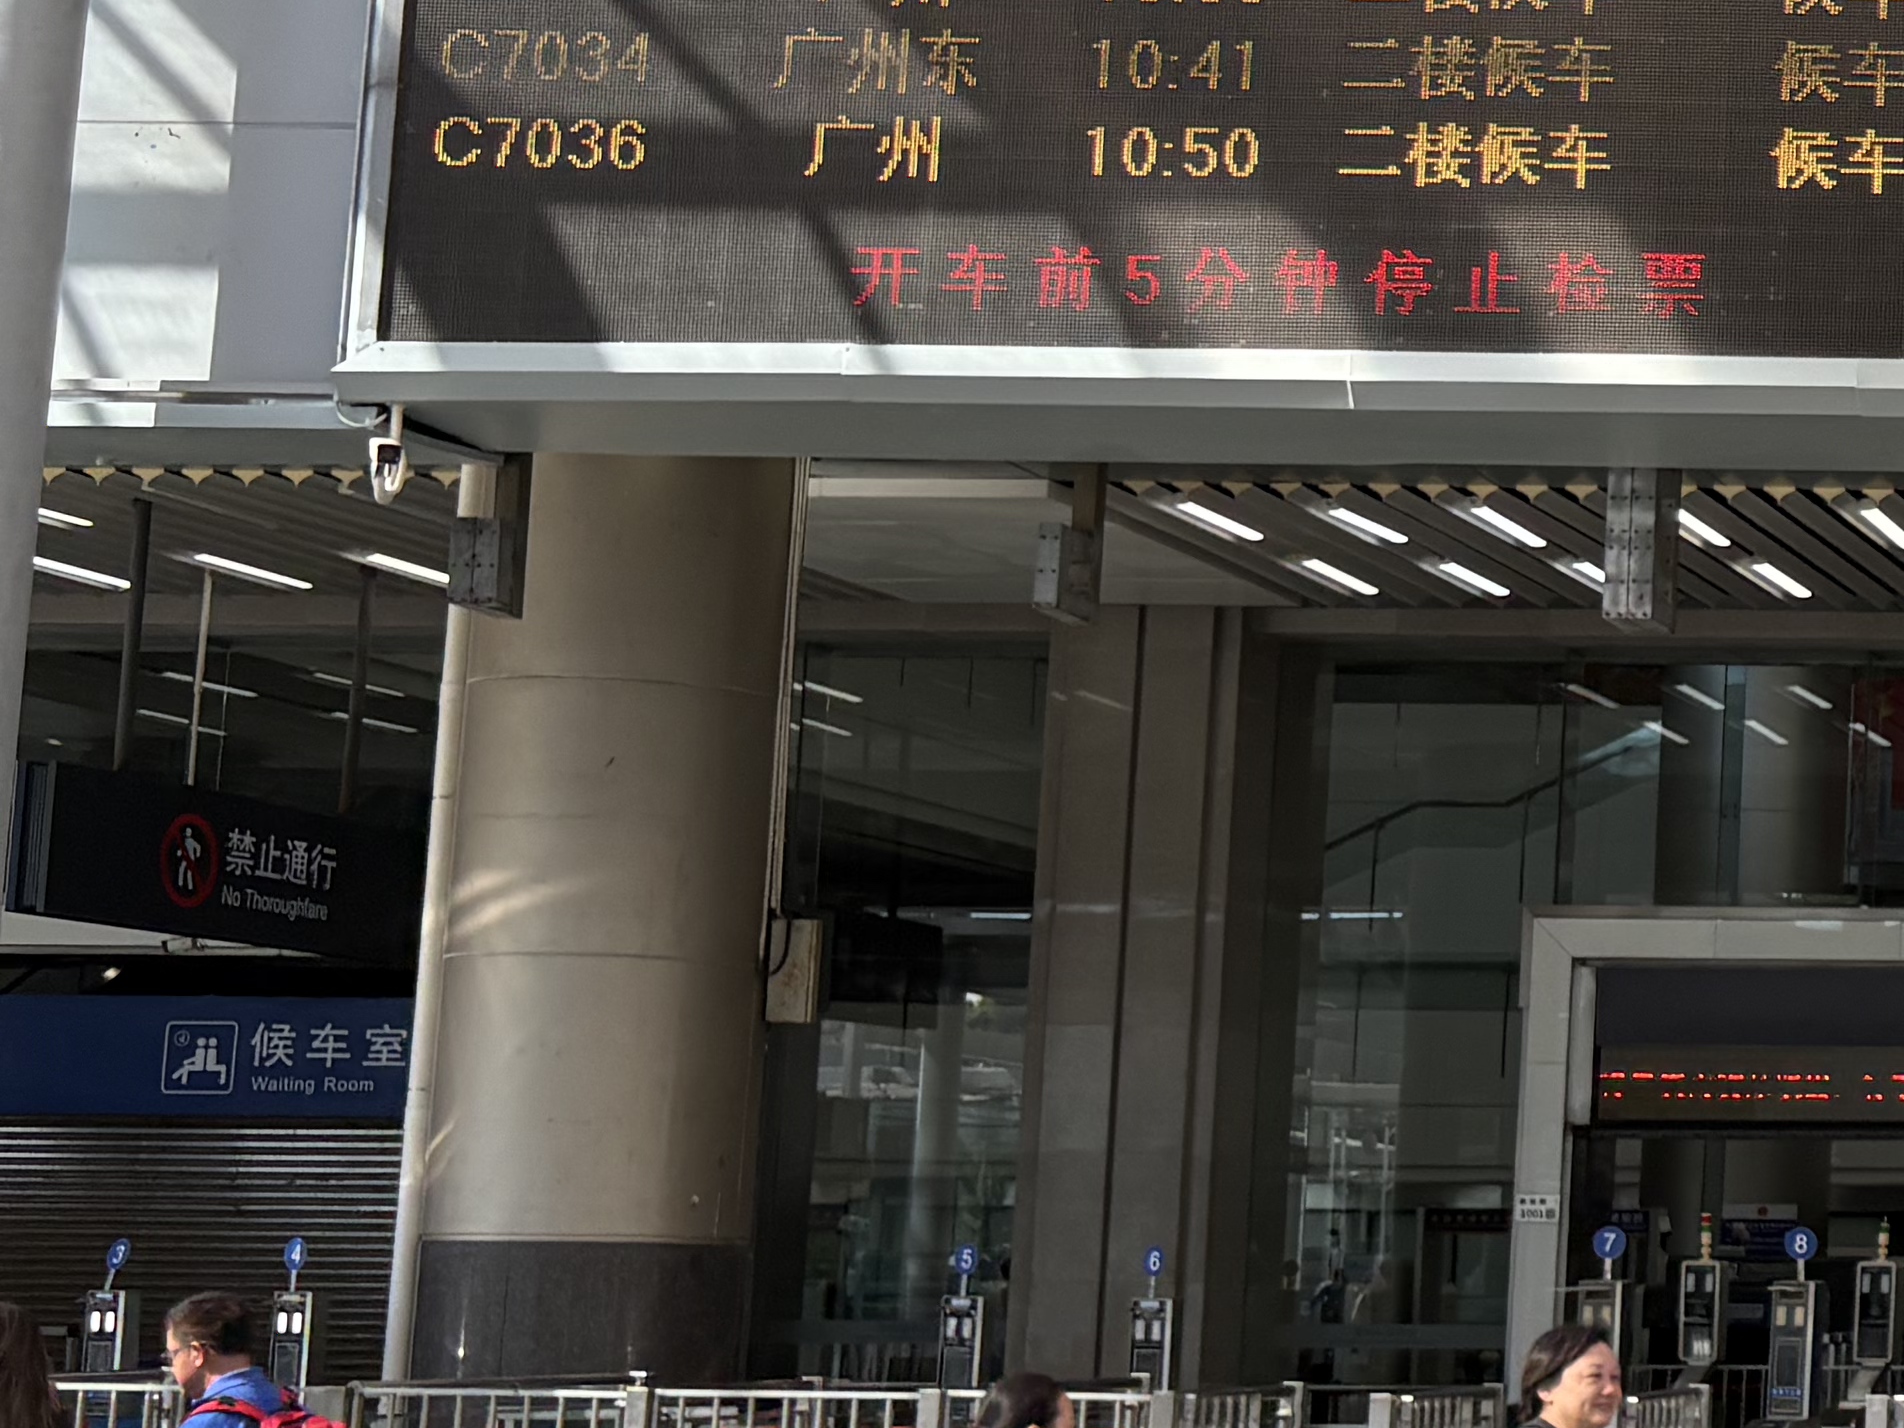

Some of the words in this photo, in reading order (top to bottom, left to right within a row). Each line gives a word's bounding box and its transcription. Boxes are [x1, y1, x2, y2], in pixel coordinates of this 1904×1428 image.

[440, 29, 651, 82] C7034
[772, 27, 980, 95] 广州东
[1091, 38, 1256, 90] 10:41
[1342, 35, 1614, 102] 二楼候车
[434, 118, 645, 170] C7036
[805, 117, 941, 182] 广州
[1089, 128, 1258, 178] 10:50
[1340, 124, 1609, 189] 二楼候车
[1771, 129, 1904, 195] 候车
[850, 245, 1708, 318] 开车前5分钟停止检票
[224, 827, 337, 891] 禁止通行
[221, 884, 241, 908] No
[245, 887, 328, 921] Thoroughfare
[250, 1021, 407, 1069] 候车室
[251, 1075, 315, 1095] Waiting
[324, 1075, 374, 1092] Room
[1604, 1232, 1616, 1252] 7
[1794, 1233, 1808, 1254] 8
[112, 1245, 125, 1264] 3
[291, 1244, 302, 1264] 4
[961, 1249, 972, 1269] 5
[1150, 1251, 1160, 1270] 6
